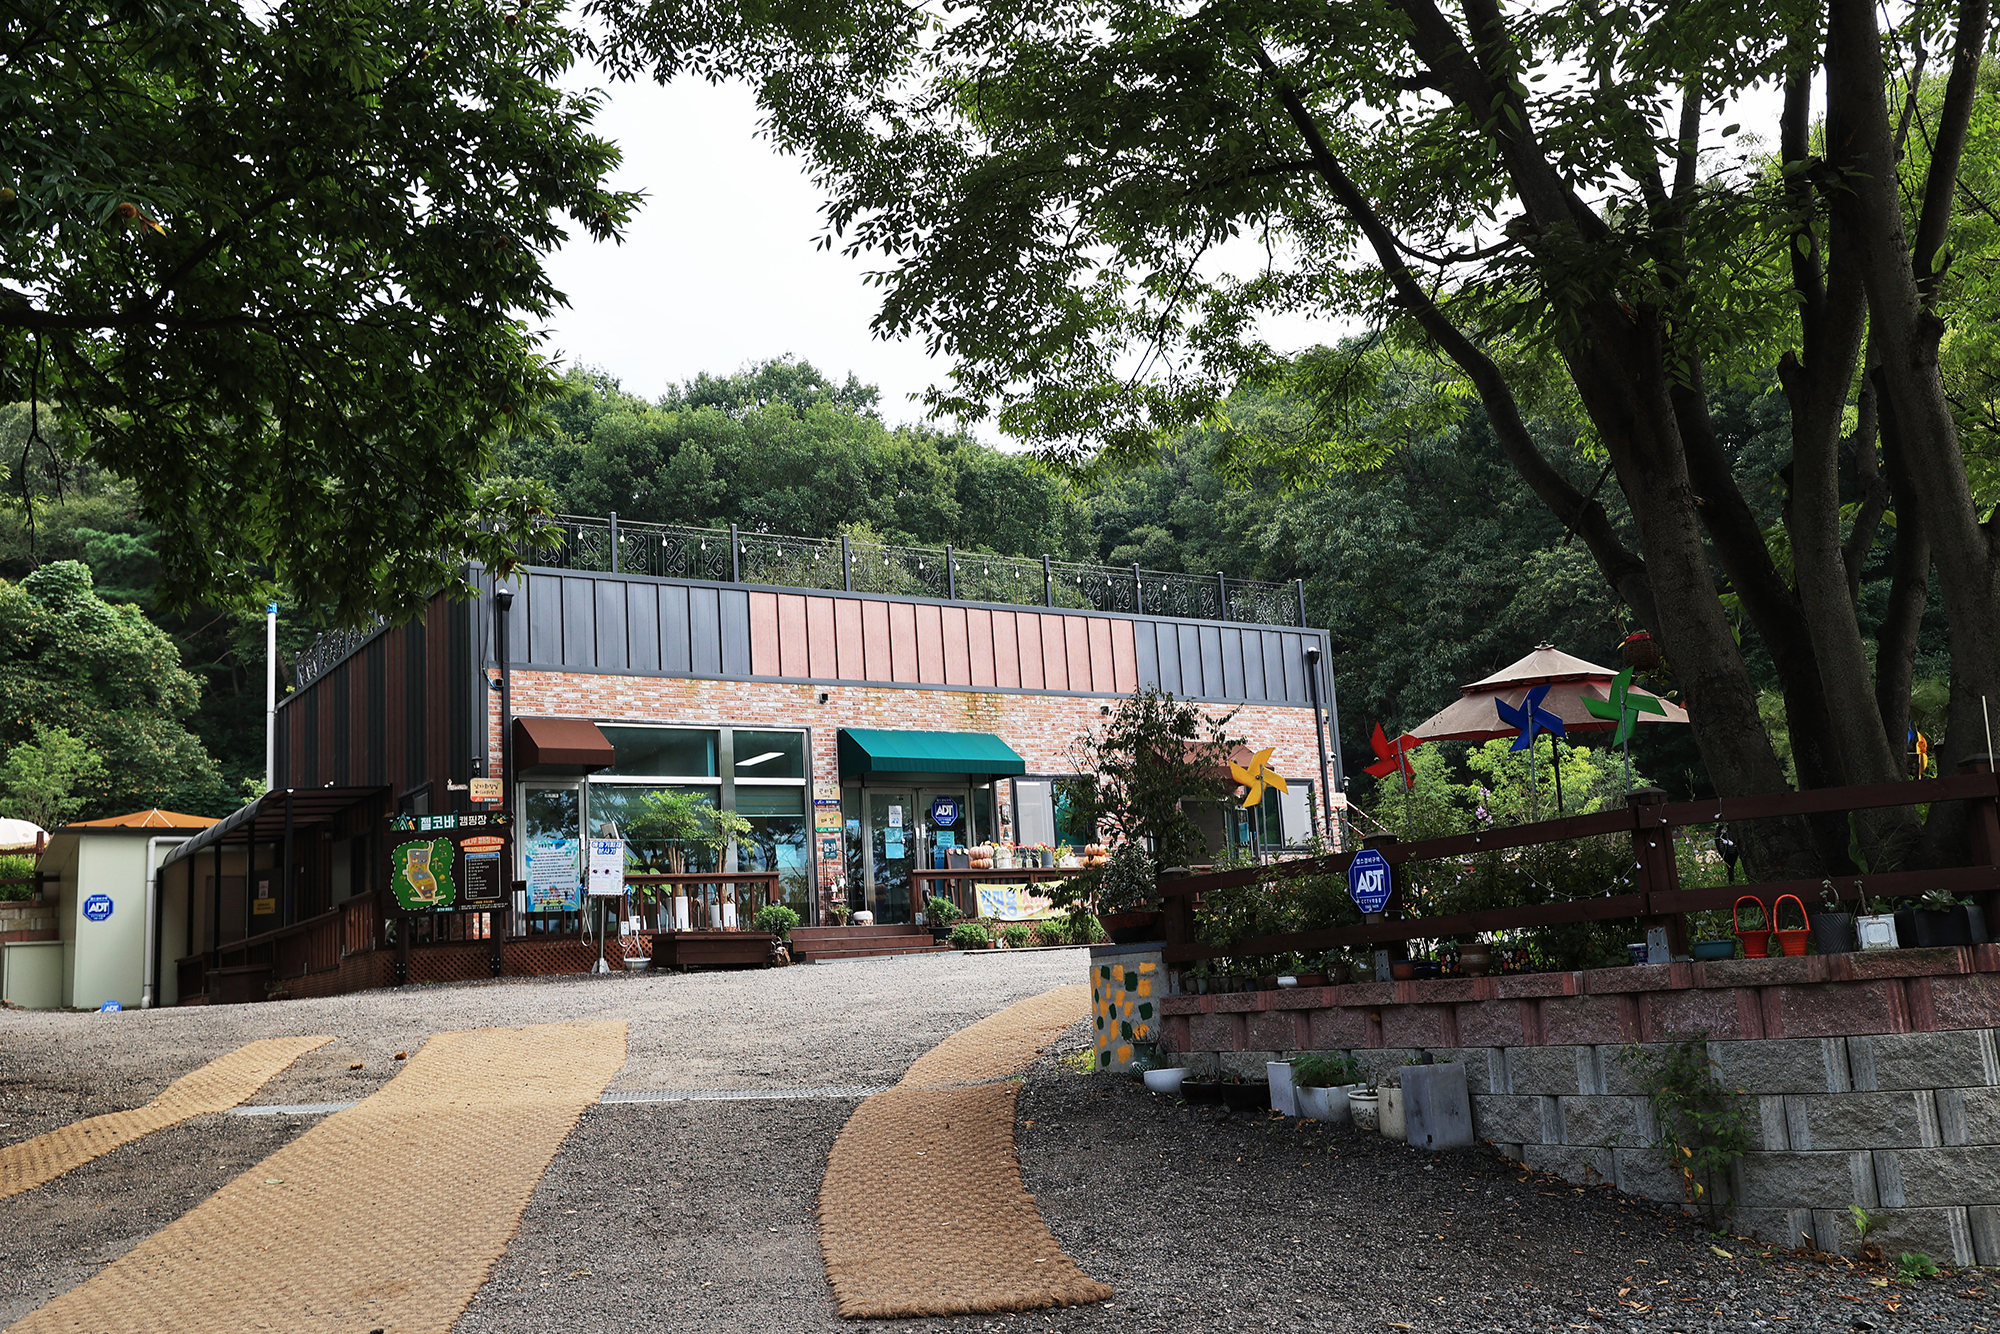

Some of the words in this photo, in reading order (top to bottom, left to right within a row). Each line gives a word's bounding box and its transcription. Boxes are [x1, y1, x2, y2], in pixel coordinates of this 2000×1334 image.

[936, 805, 953, 816] ADT
[420, 815, 455, 831] 젤코바
[459, 814, 487, 827] 캠핑장
[1356, 869, 1384, 893] ADT
[88, 902, 109, 912] ADT
